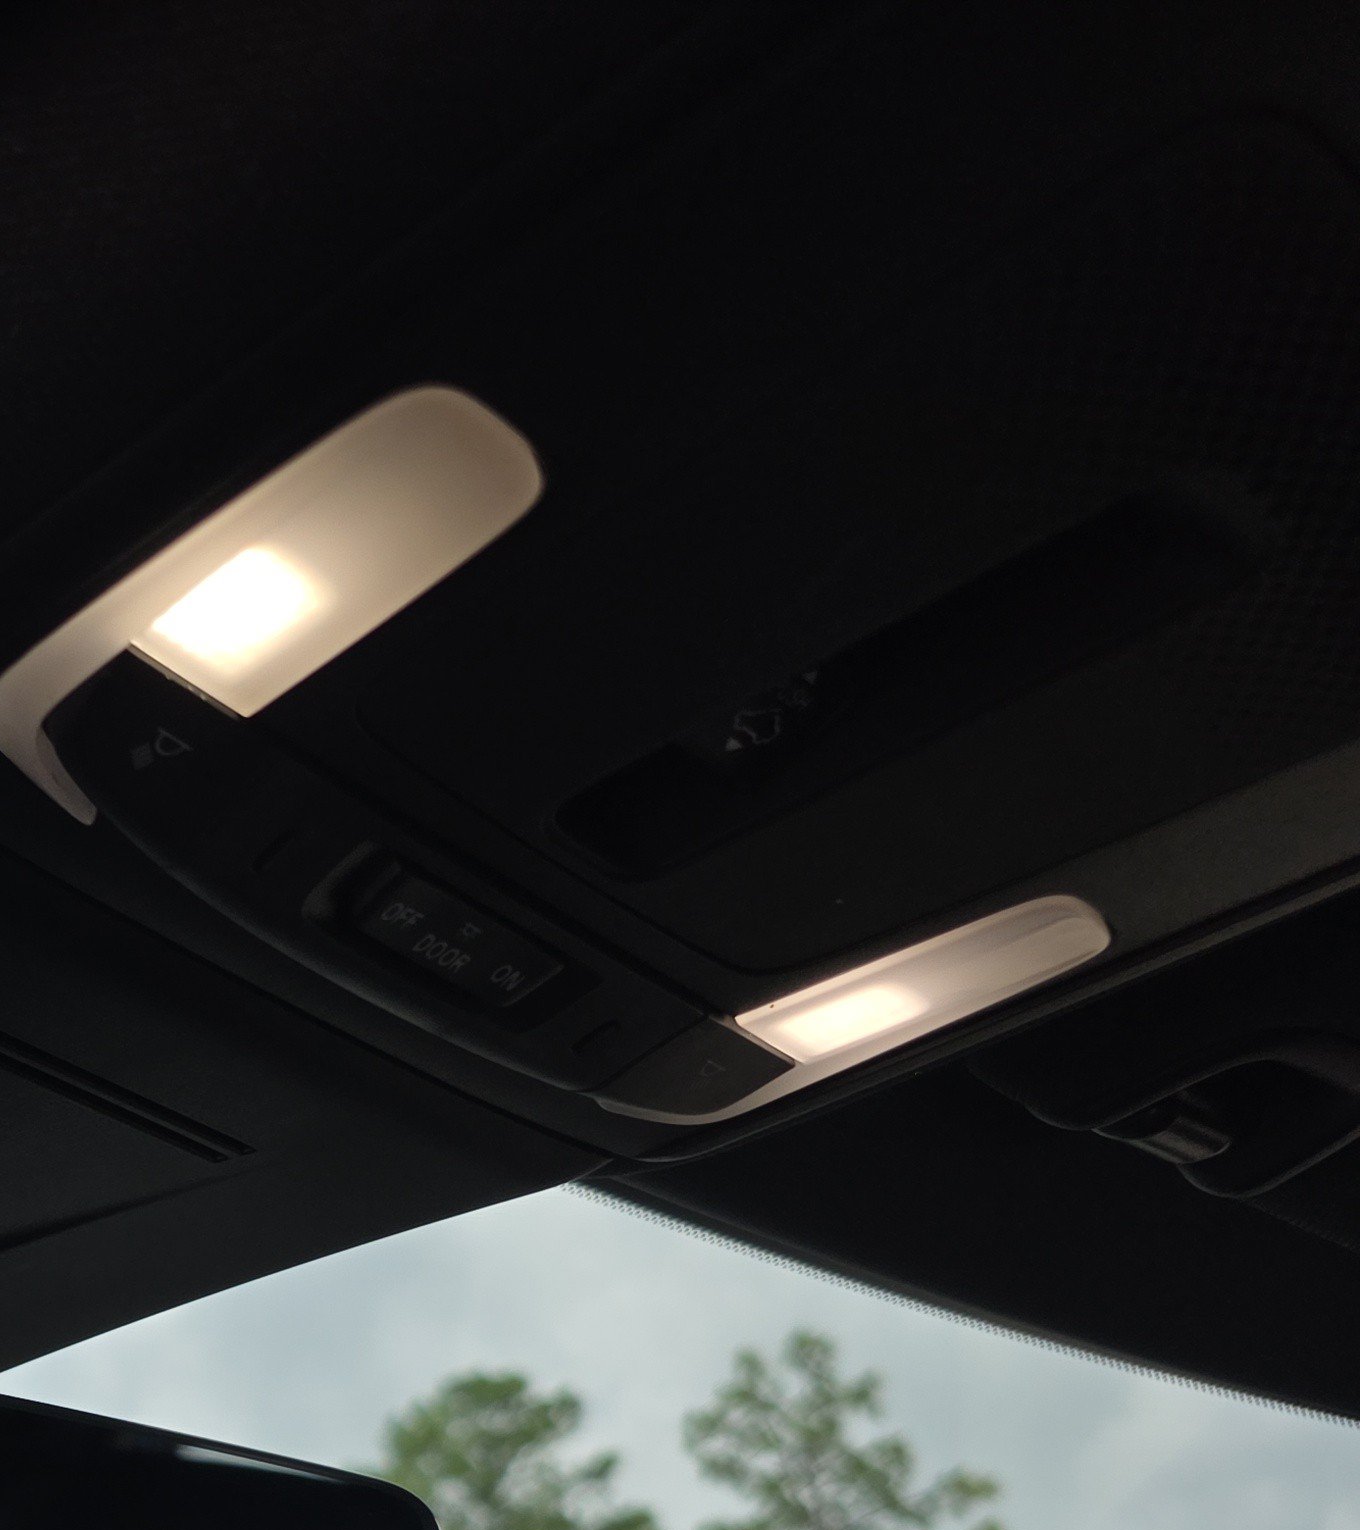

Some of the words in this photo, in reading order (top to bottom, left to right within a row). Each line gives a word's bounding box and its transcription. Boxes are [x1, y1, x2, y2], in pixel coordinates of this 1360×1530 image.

[381, 903, 424, 928] OFF
[412, 934, 472, 973] DOOR
[490, 964, 526, 992] ON
